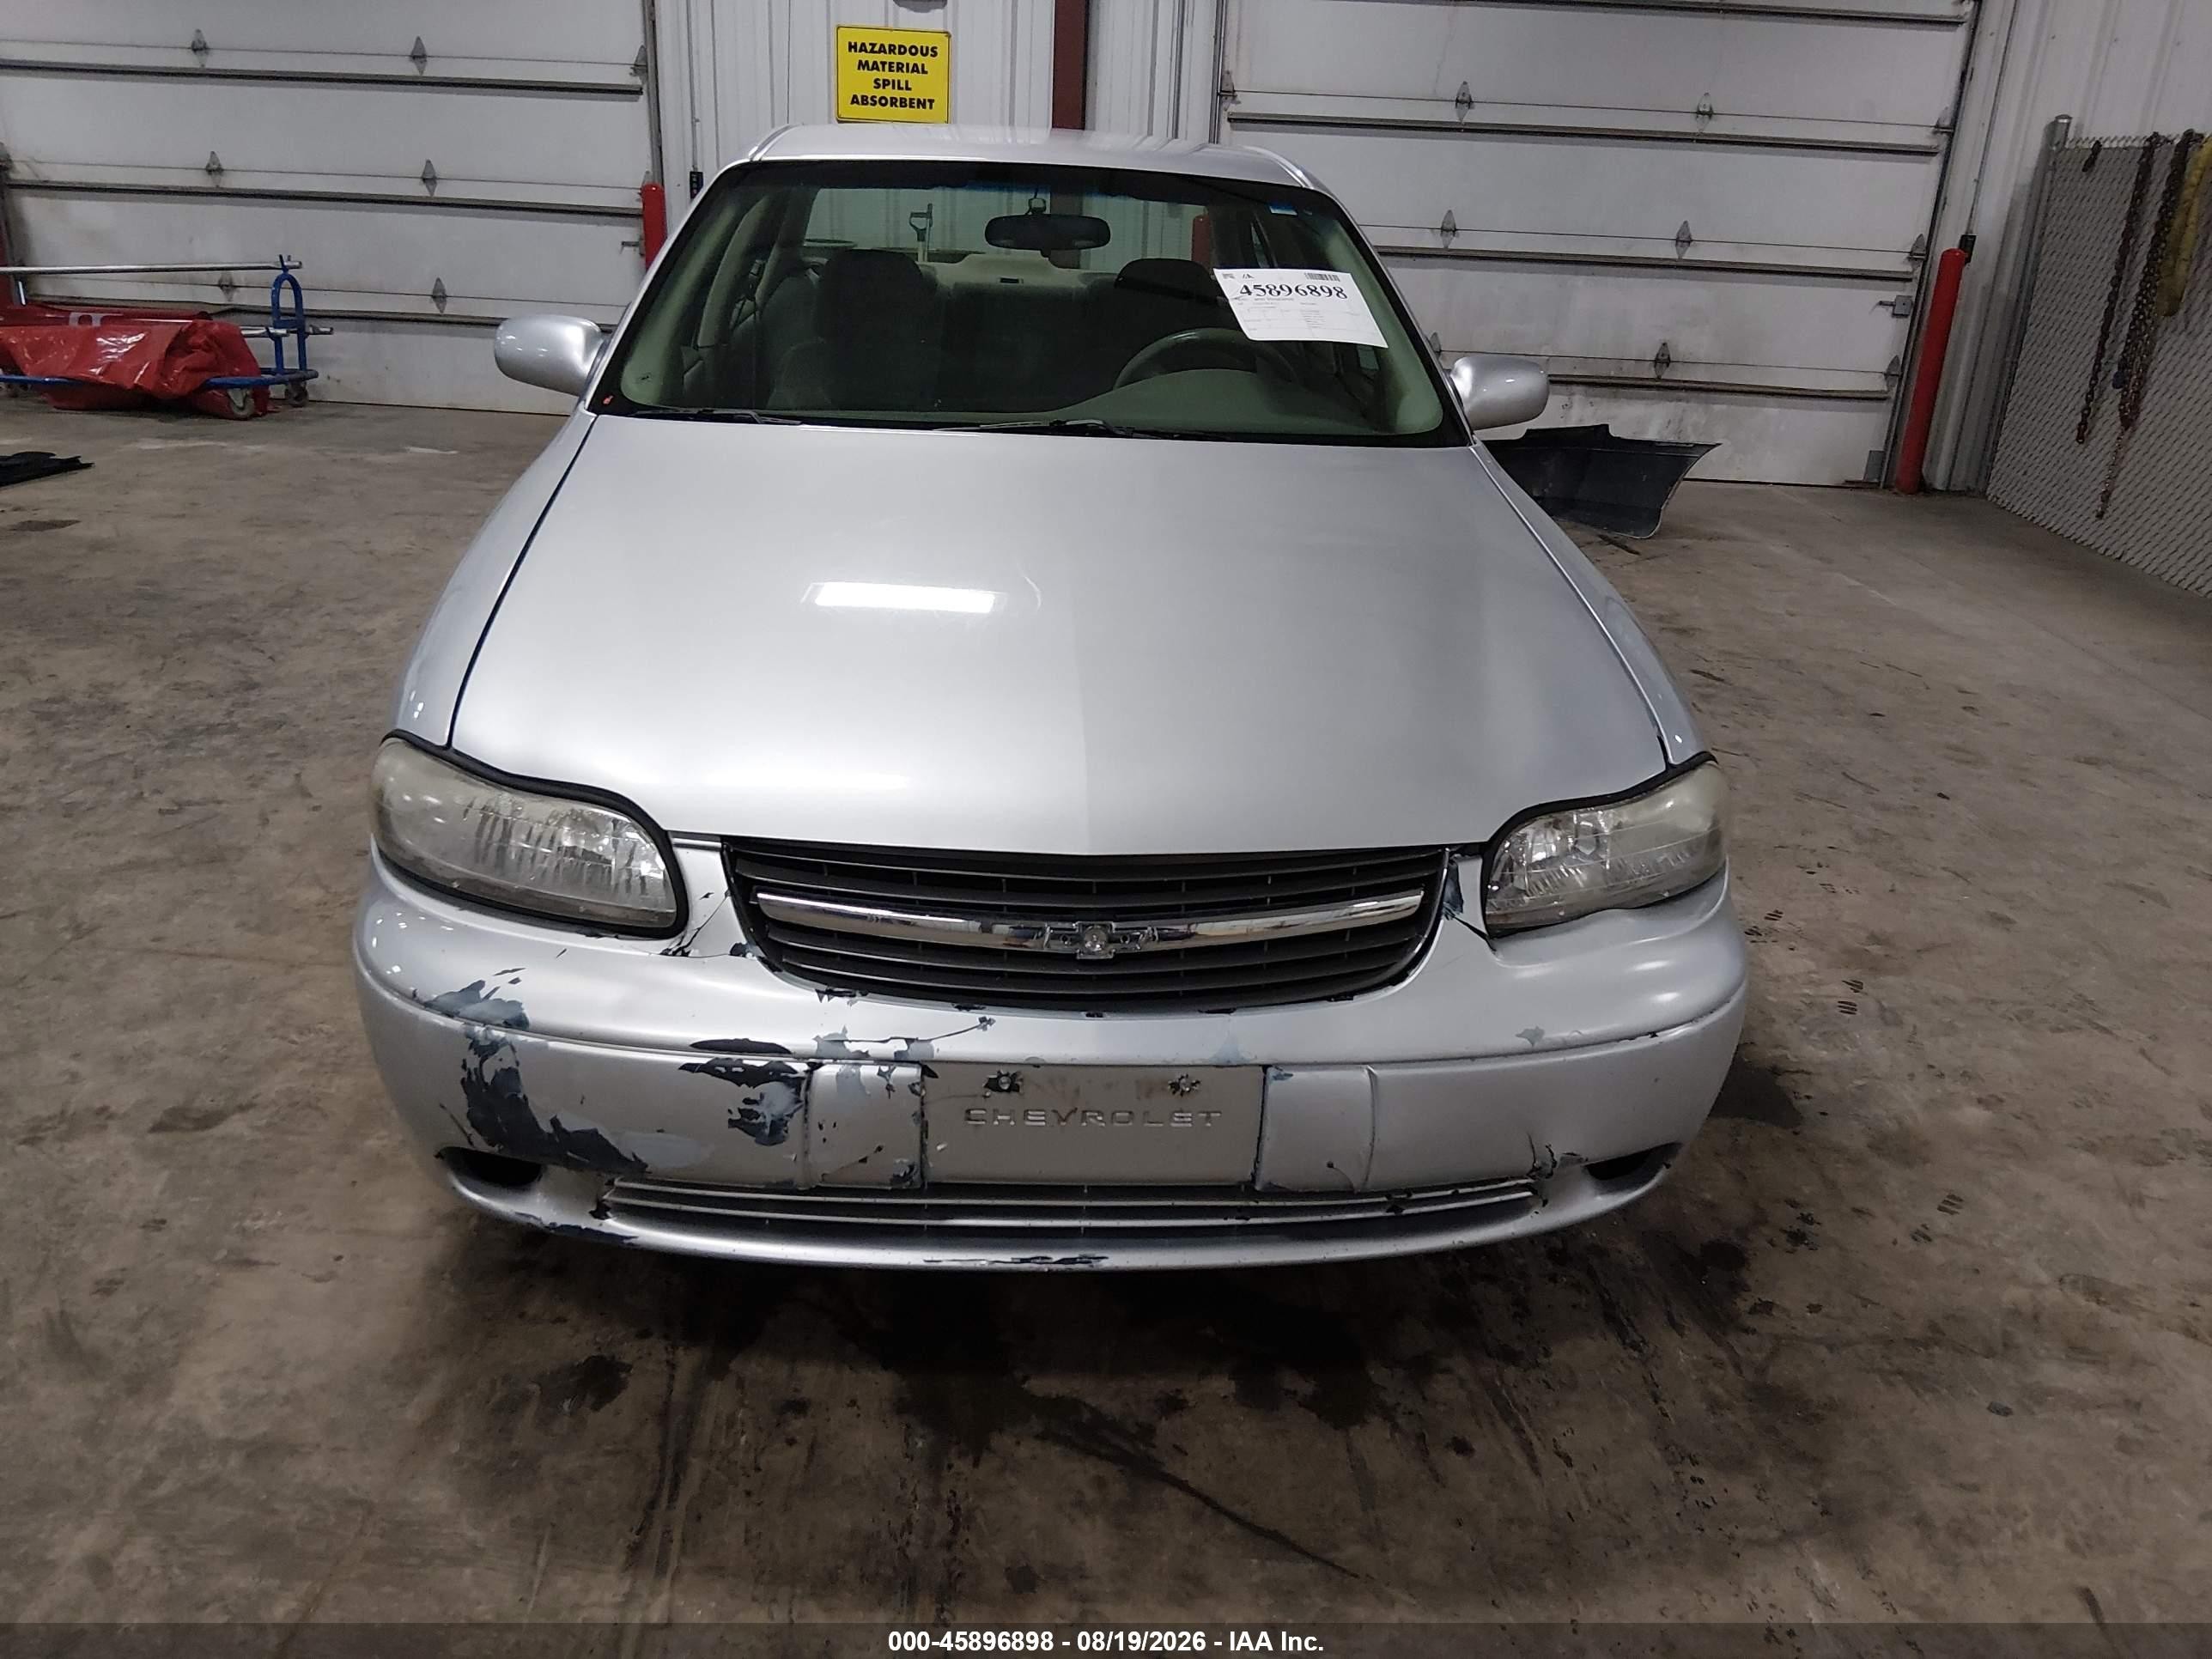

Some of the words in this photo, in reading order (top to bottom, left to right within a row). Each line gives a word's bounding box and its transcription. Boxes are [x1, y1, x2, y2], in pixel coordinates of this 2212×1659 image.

[848, 41, 938, 58] HAZARDOUS
[857, 59, 928, 75] MATERIAL
[873, 78, 912, 91] SPILL
[850, 94, 935, 110] ABSORBENT
[1239, 283, 1348, 300] 45896898
[964, 1107, 1222, 1127] CHEVROLET
